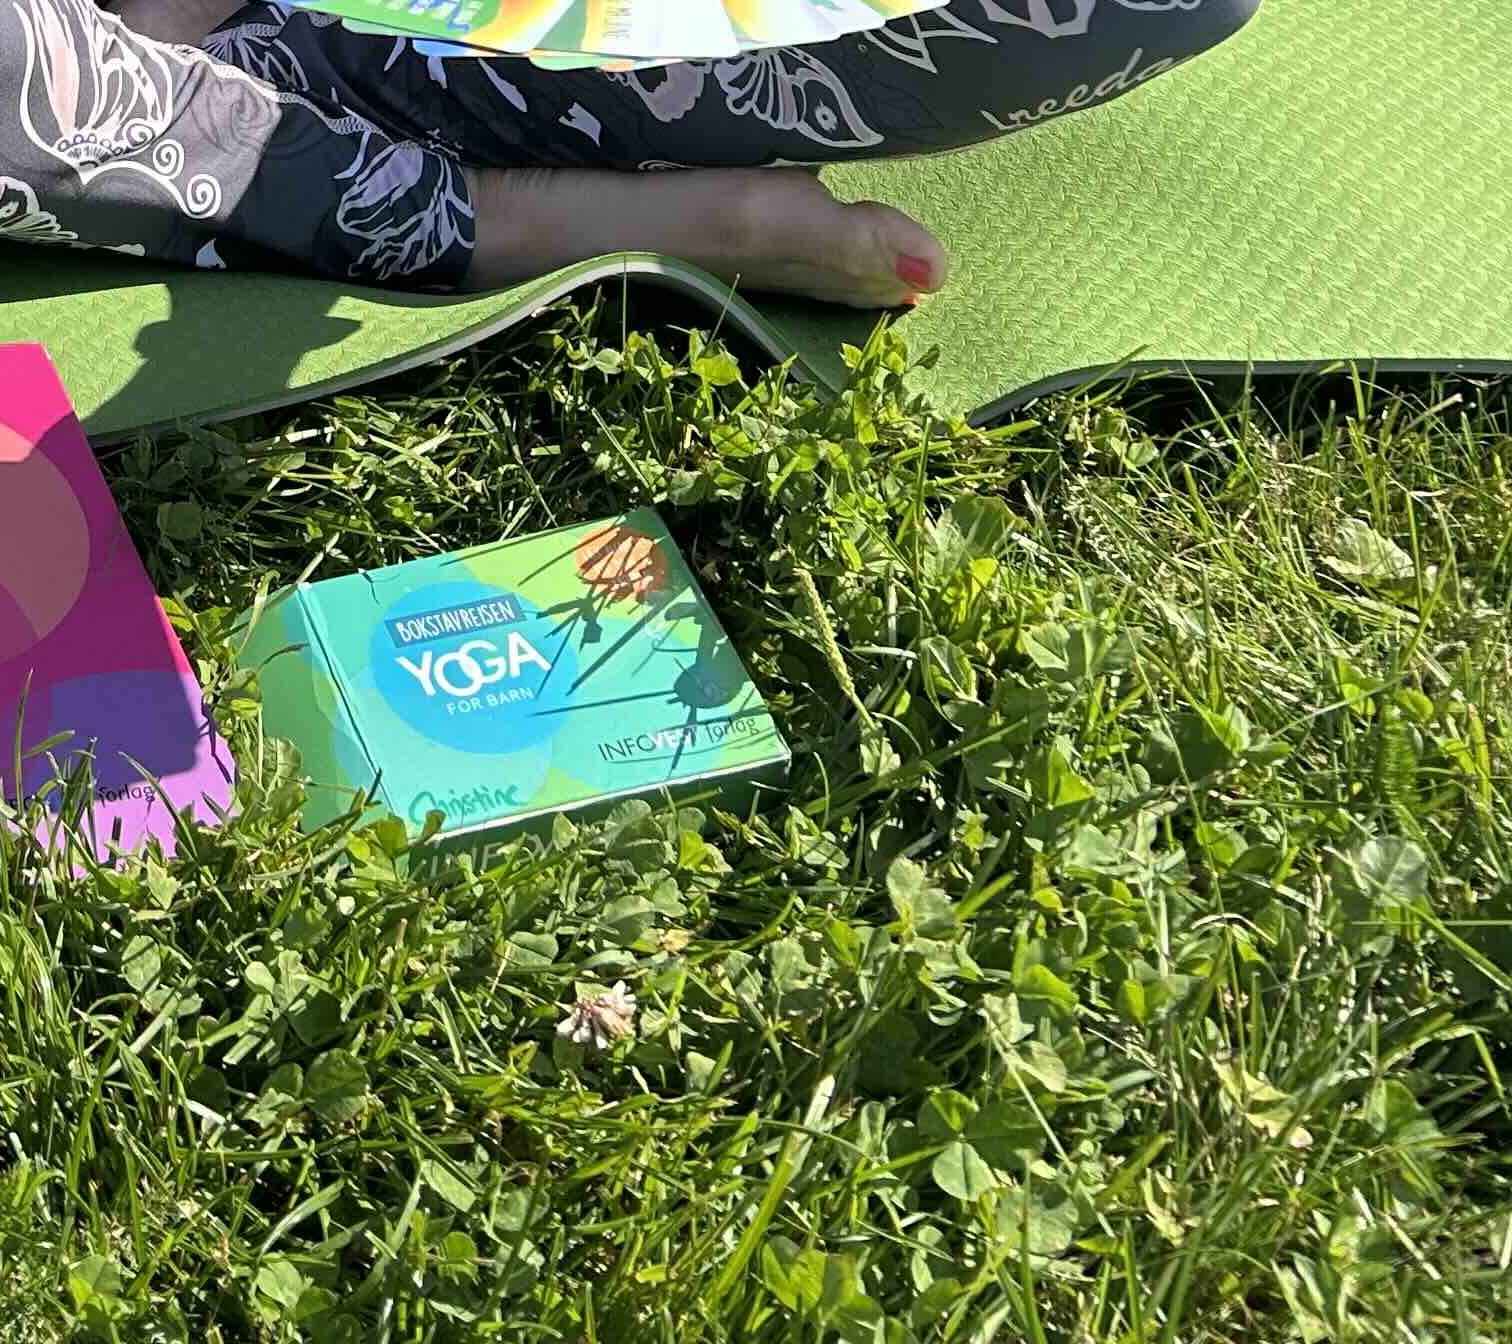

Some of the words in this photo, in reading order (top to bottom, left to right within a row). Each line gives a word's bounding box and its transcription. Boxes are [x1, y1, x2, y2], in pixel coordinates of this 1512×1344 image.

[395, 599, 516, 642] BOKSTAVREISEN
[395, 630, 552, 697] YOGA
[445, 696, 484, 716] FOR
[486, 687, 535, 707] BARN
